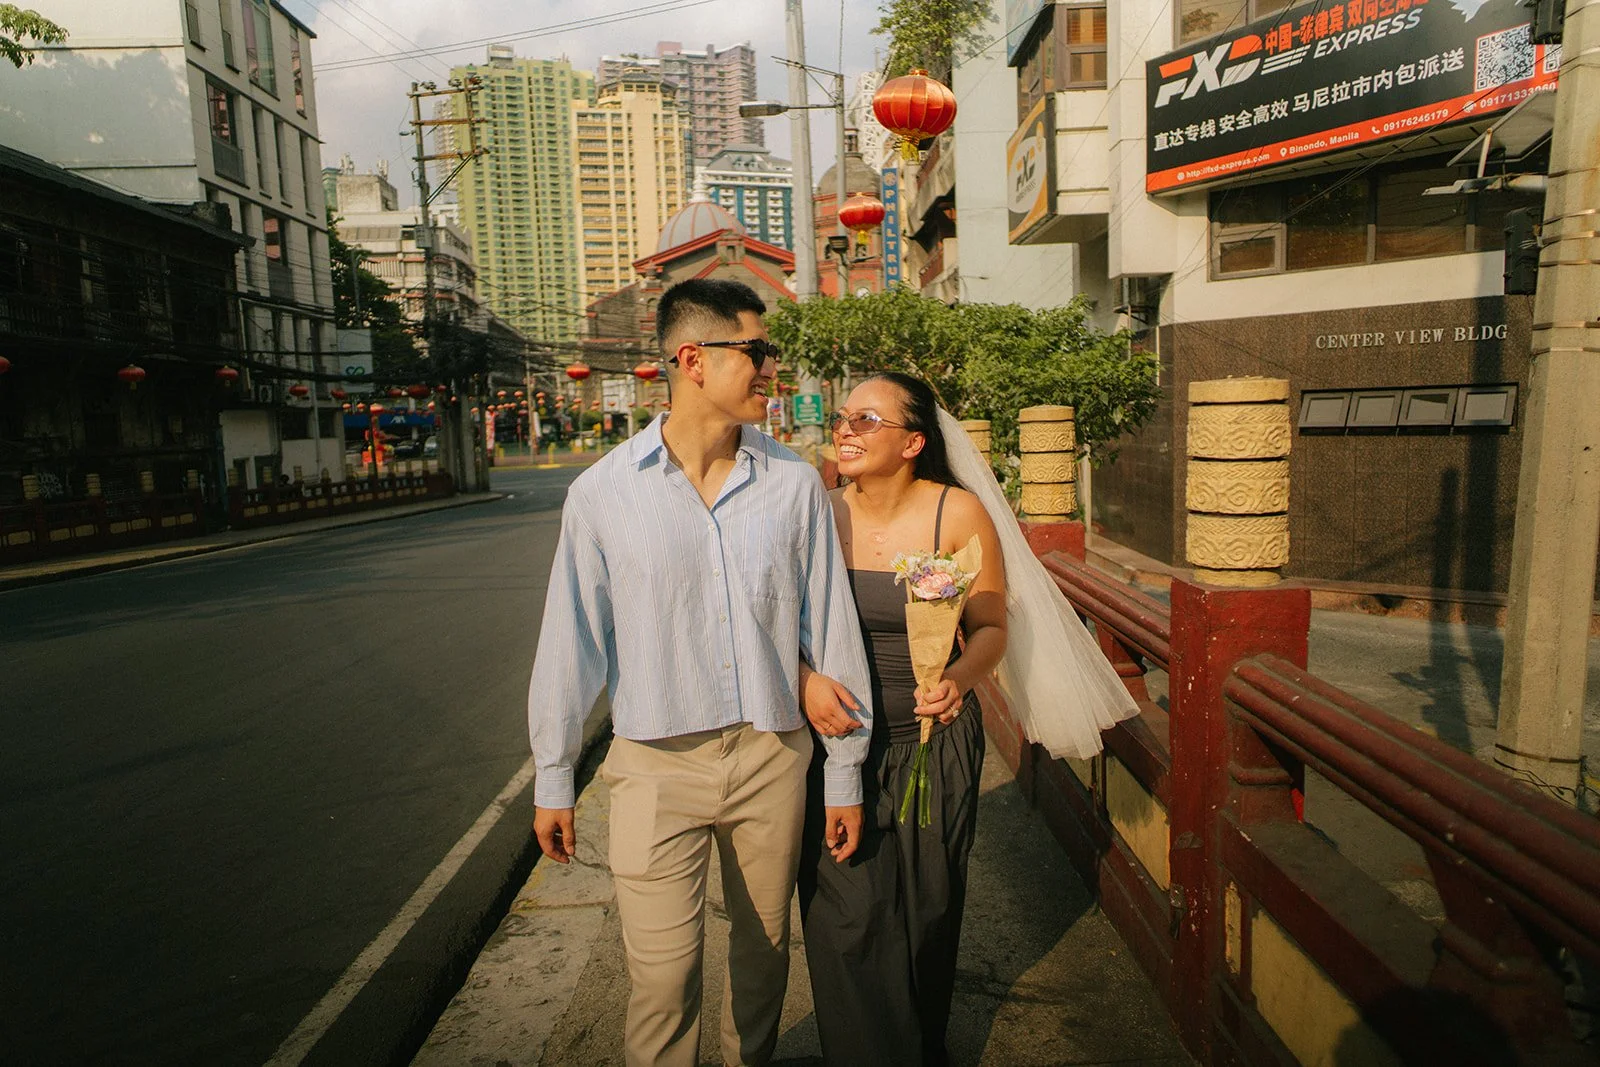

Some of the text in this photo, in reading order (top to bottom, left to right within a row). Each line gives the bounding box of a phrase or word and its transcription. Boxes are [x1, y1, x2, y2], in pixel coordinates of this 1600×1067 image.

[1313, 8, 1423, 59] EXPRESS
[1154, 47, 1465, 152] 直达专线 安全高效 马尼拉市内包派送
[1289, 131, 1360, 155] Binondo, Manila
[1315, 324, 1508, 349] CENTER VIEW BLDG
